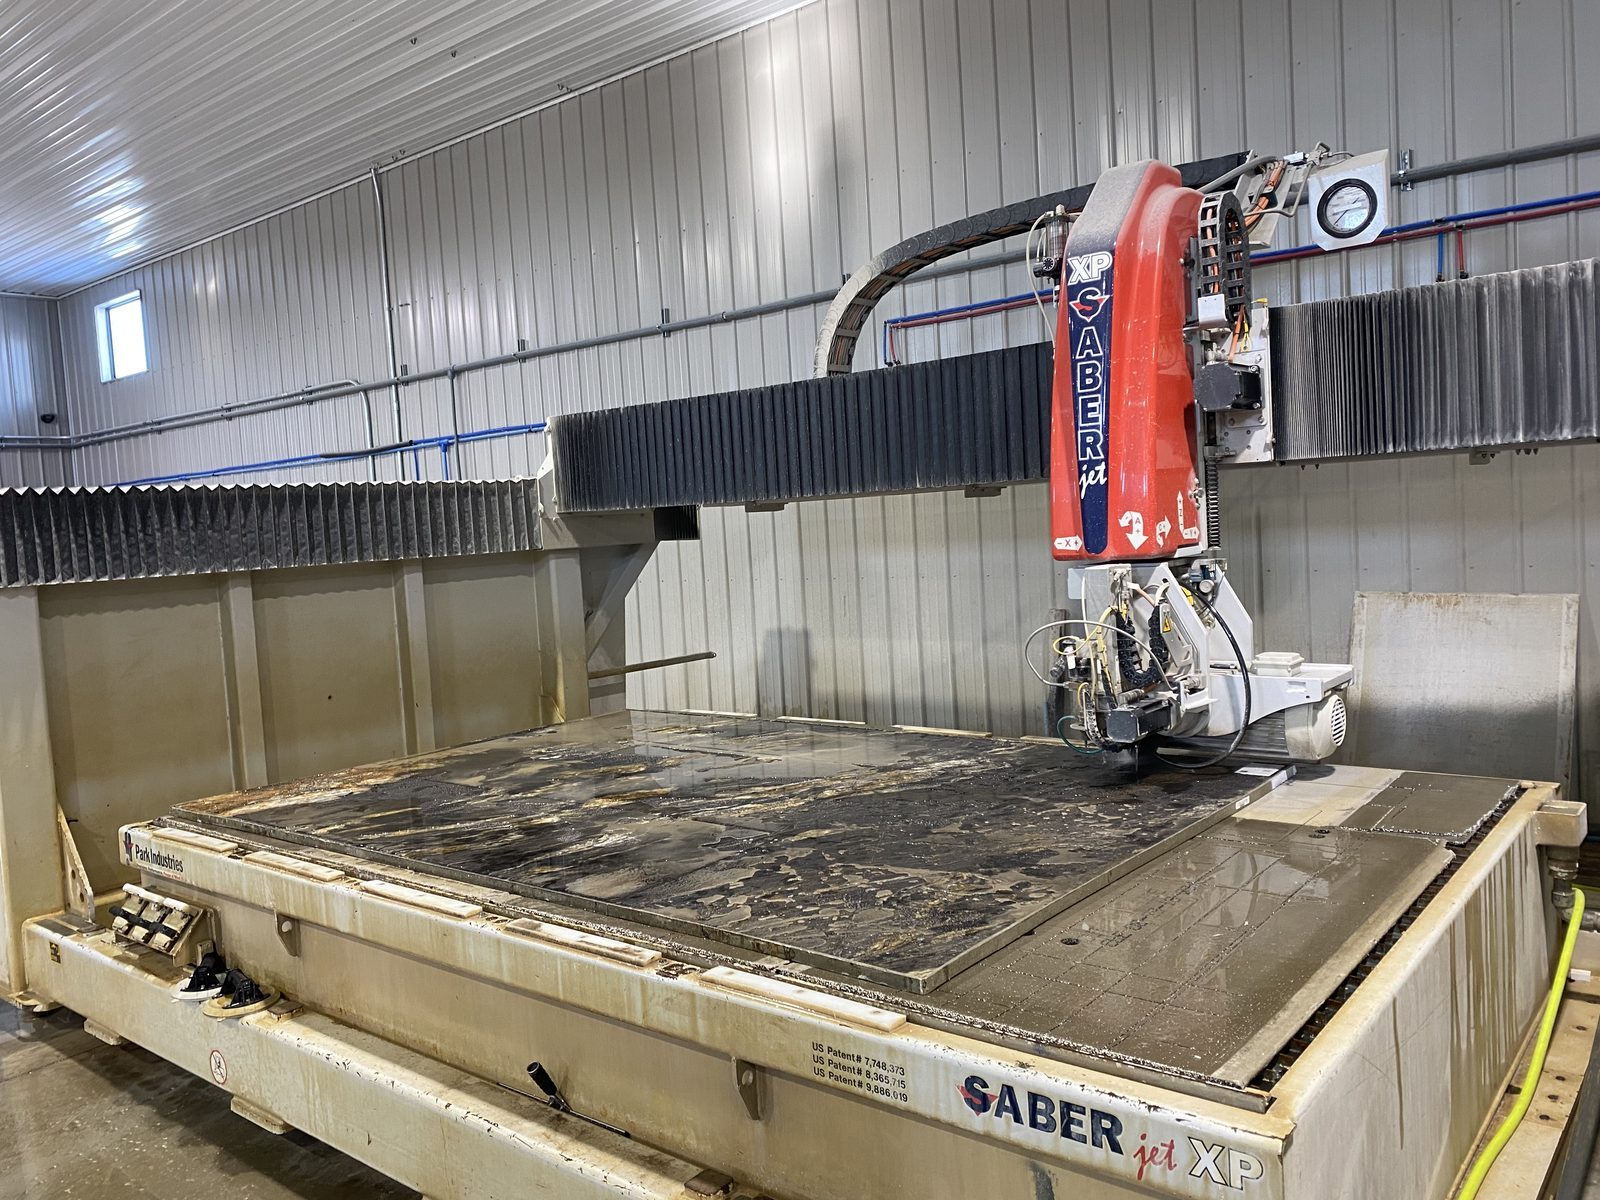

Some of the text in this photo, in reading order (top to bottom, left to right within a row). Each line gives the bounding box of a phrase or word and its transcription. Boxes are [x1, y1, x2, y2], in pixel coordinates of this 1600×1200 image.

[1067, 250, 1113, 286] XP
[1075, 287, 1104, 461] SABER
[1078, 462, 1108, 500] jet
[135, 844, 150, 863] Park
[150, 848, 184, 873] Industries
[812, 1041, 905, 1077] US Patent# 7,748,373
[812, 1054, 906, 1090] US Patent# 8,365,715
[813, 1067, 826, 1078] US
[828, 1071, 864, 1089] Patent#
[962, 1075, 1265, 1191] SABER jet XP
